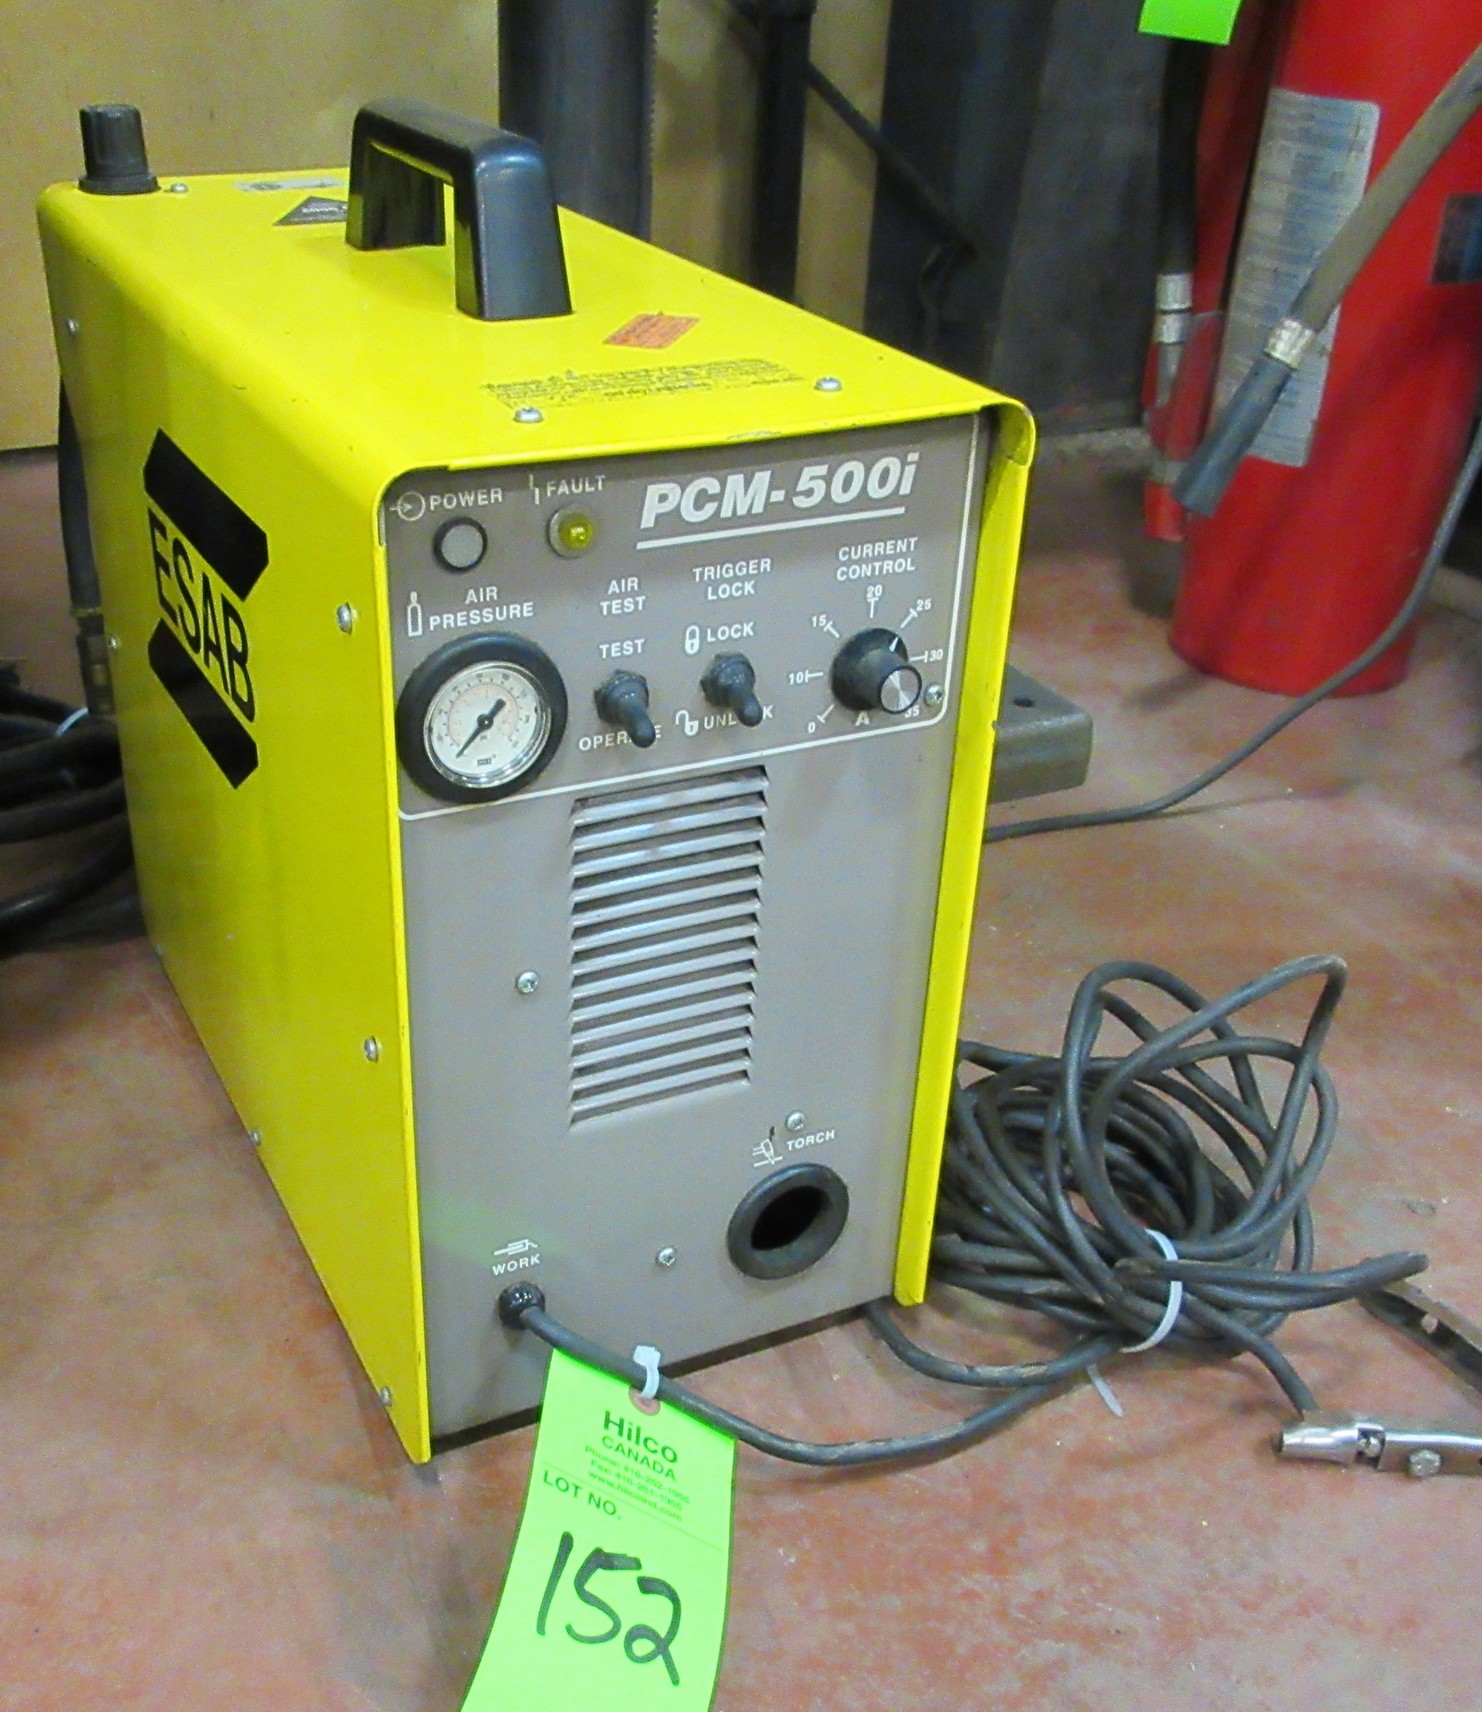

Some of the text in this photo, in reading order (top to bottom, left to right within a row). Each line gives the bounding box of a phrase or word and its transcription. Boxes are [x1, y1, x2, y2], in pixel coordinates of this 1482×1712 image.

[546, 475, 606, 498] FAULT
[640, 452, 919, 529] PCM-500i
[429, 487, 503, 511] POWER
[838, 537, 918, 562] CURRENT
[692, 558, 771, 583] TRIGGER
[836, 557, 916, 582] CONTROL
[465, 586, 498, 605] AIR
[607, 577, 639, 596] AIR
[707, 580, 755, 601] LOCK
[866, 584, 882, 598] 20
[147, 506, 255, 723] ESAB
[429, 602, 534, 631] PRESSURE
[599, 596, 646, 617] TEST
[916, 599, 932, 612] 25
[706, 622, 754, 643] LOCK
[811, 615, 826, 628] 15
[599, 639, 646, 659] TEST
[929, 649, 943, 662] 30
[788, 671, 804, 684] 10
[703, 705, 773, 730] UNLK
[807, 722, 816, 734] 0
[855, 711, 870, 726] A
[578, 725, 662, 751] OPERE
[786, 1129, 835, 1151] TORCH
[492, 1253, 541, 1276] WORK
[603, 1410, 678, 1463] Hilco
[602, 1435, 676, 1481] CANADA
[543, 1470, 623, 1521] LOT NO.
[536, 1531, 682, 1687] 152
